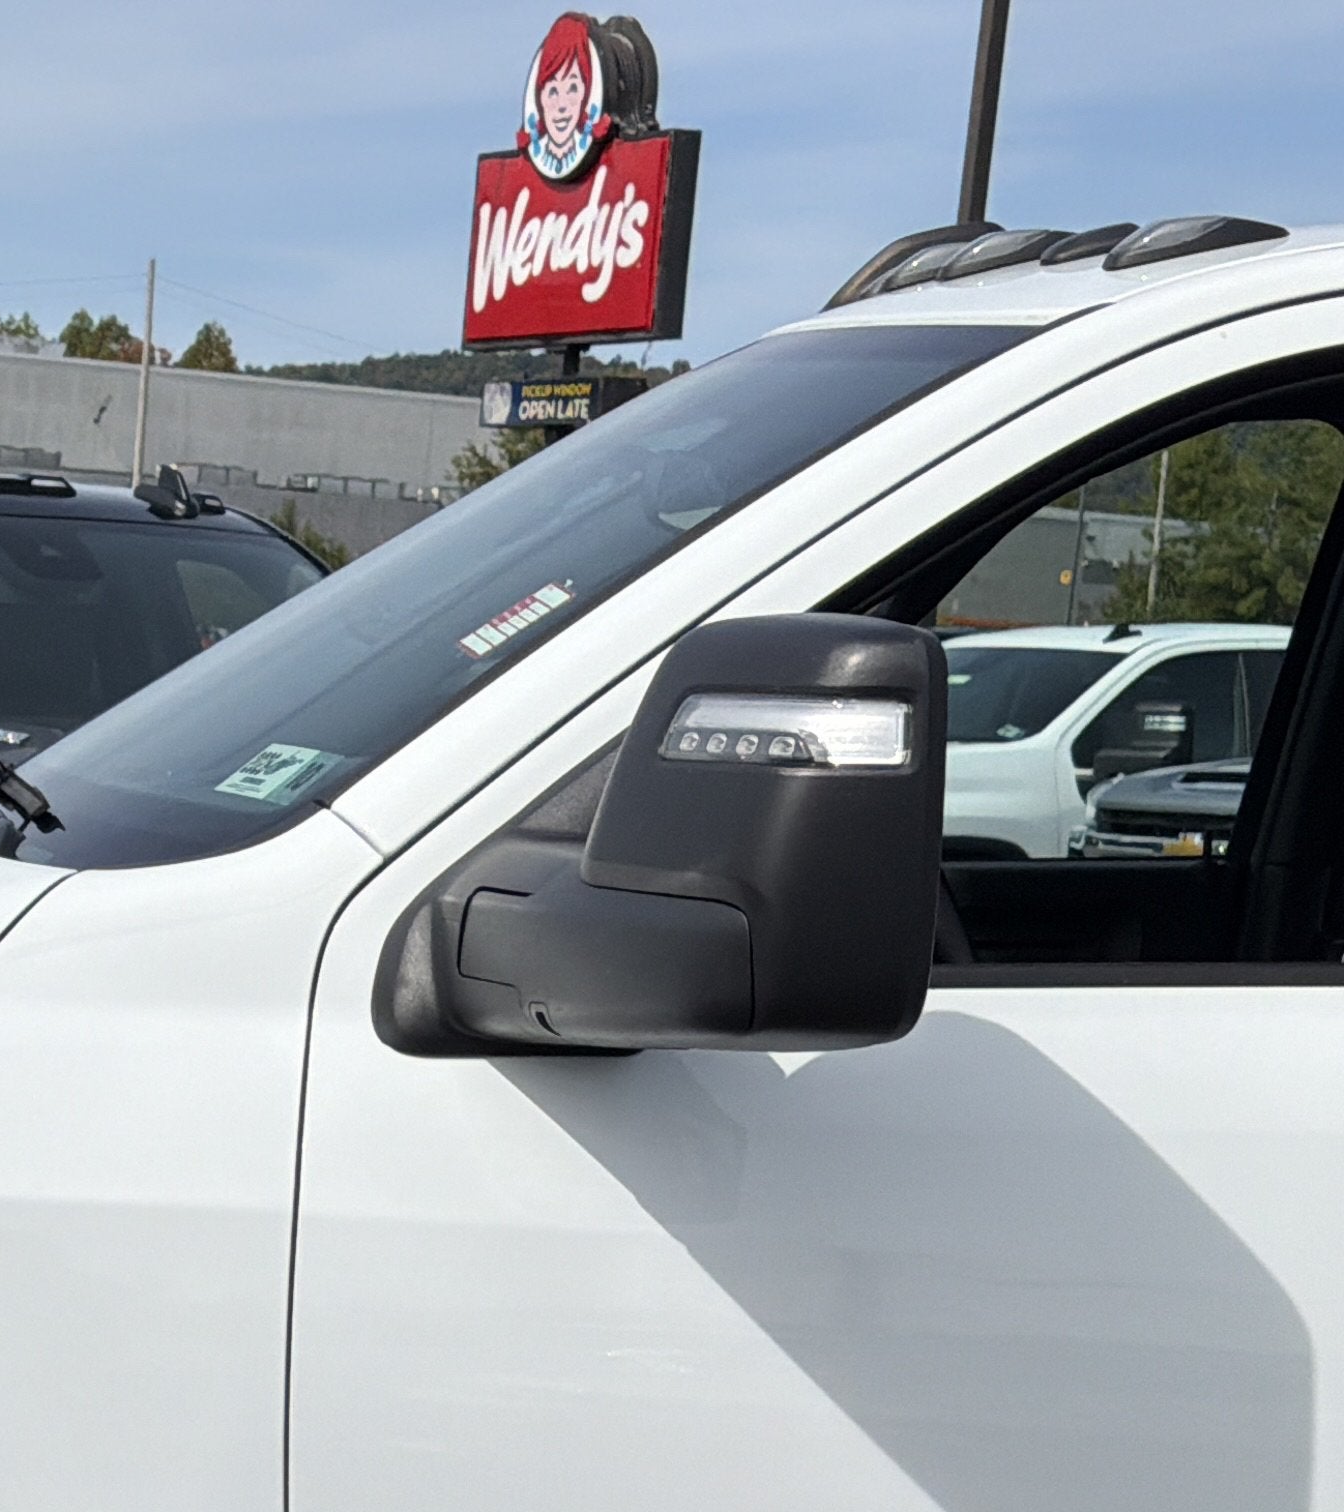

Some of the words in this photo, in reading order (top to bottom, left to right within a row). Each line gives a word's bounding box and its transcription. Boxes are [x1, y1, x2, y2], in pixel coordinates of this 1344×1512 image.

[473, 165, 649, 313] Wendy's
[521, 384, 552, 397] PICKUP
[553, 383, 593, 396] WINDOW
[518, 399, 555, 420] OPEN
[556, 398, 591, 419] LATE
